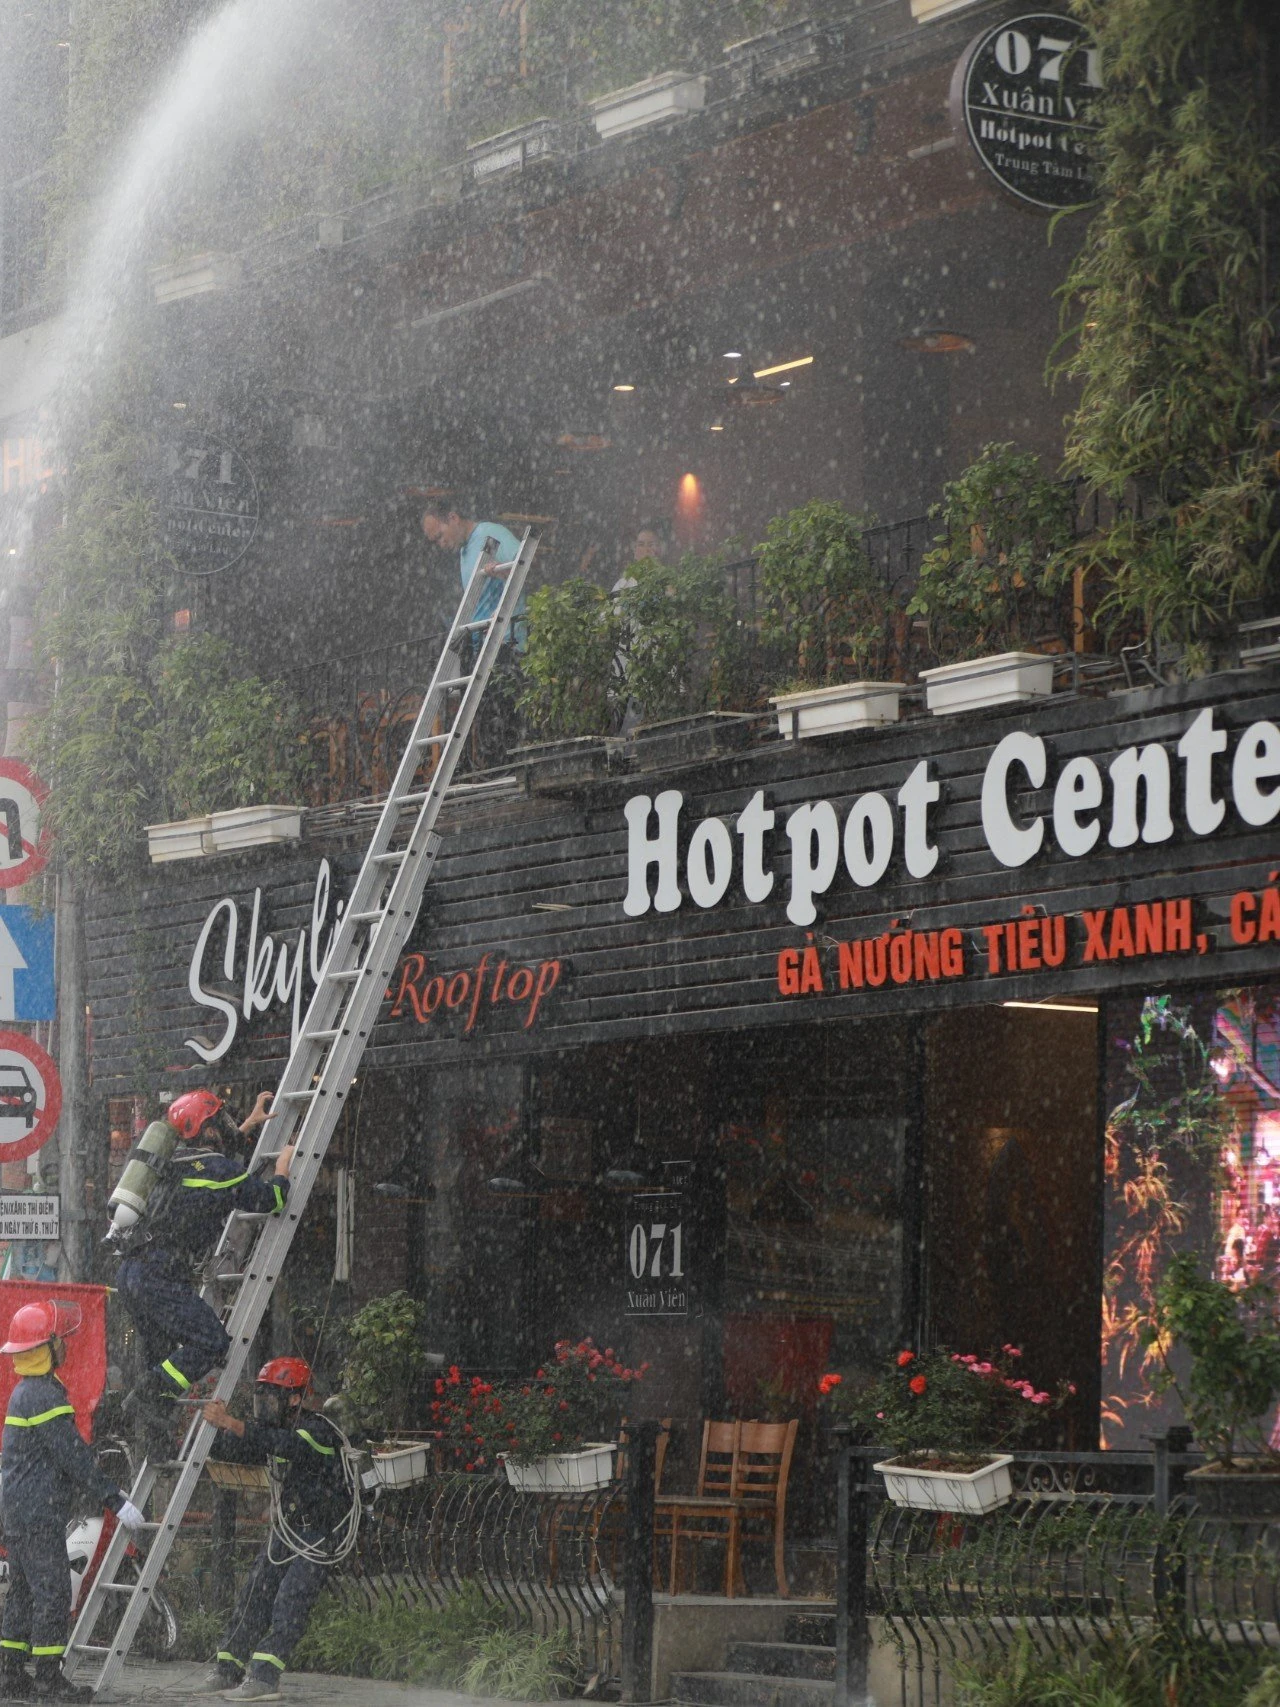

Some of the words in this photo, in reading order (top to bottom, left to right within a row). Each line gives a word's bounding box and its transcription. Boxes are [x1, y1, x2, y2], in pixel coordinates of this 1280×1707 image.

[995, 30, 1108, 89] 071
[981, 82, 1054, 116] Xuân
[980, 119, 1053, 150] Hotpot
[995, 153, 1039, 174] Trung
[622, 759, 940, 927] Hotpot
[981, 707, 1280, 869] Cente
[184, 858, 380, 1063] Skyli
[777, 932, 823, 996] GÀ
[838, 919, 965, 989] NƯỚNG
[983, 903, 1066, 975] TIÊU
[1082, 898, 1208, 962] XANH,
[1230, 870, 1280, 945] CÁ
[389, 952, 561, 1032] Rooftop
[629, 1222, 685, 1279] 071
[627, 1288, 656, 1308] Xuân
[660, 1288, 685, 1309] Viên
